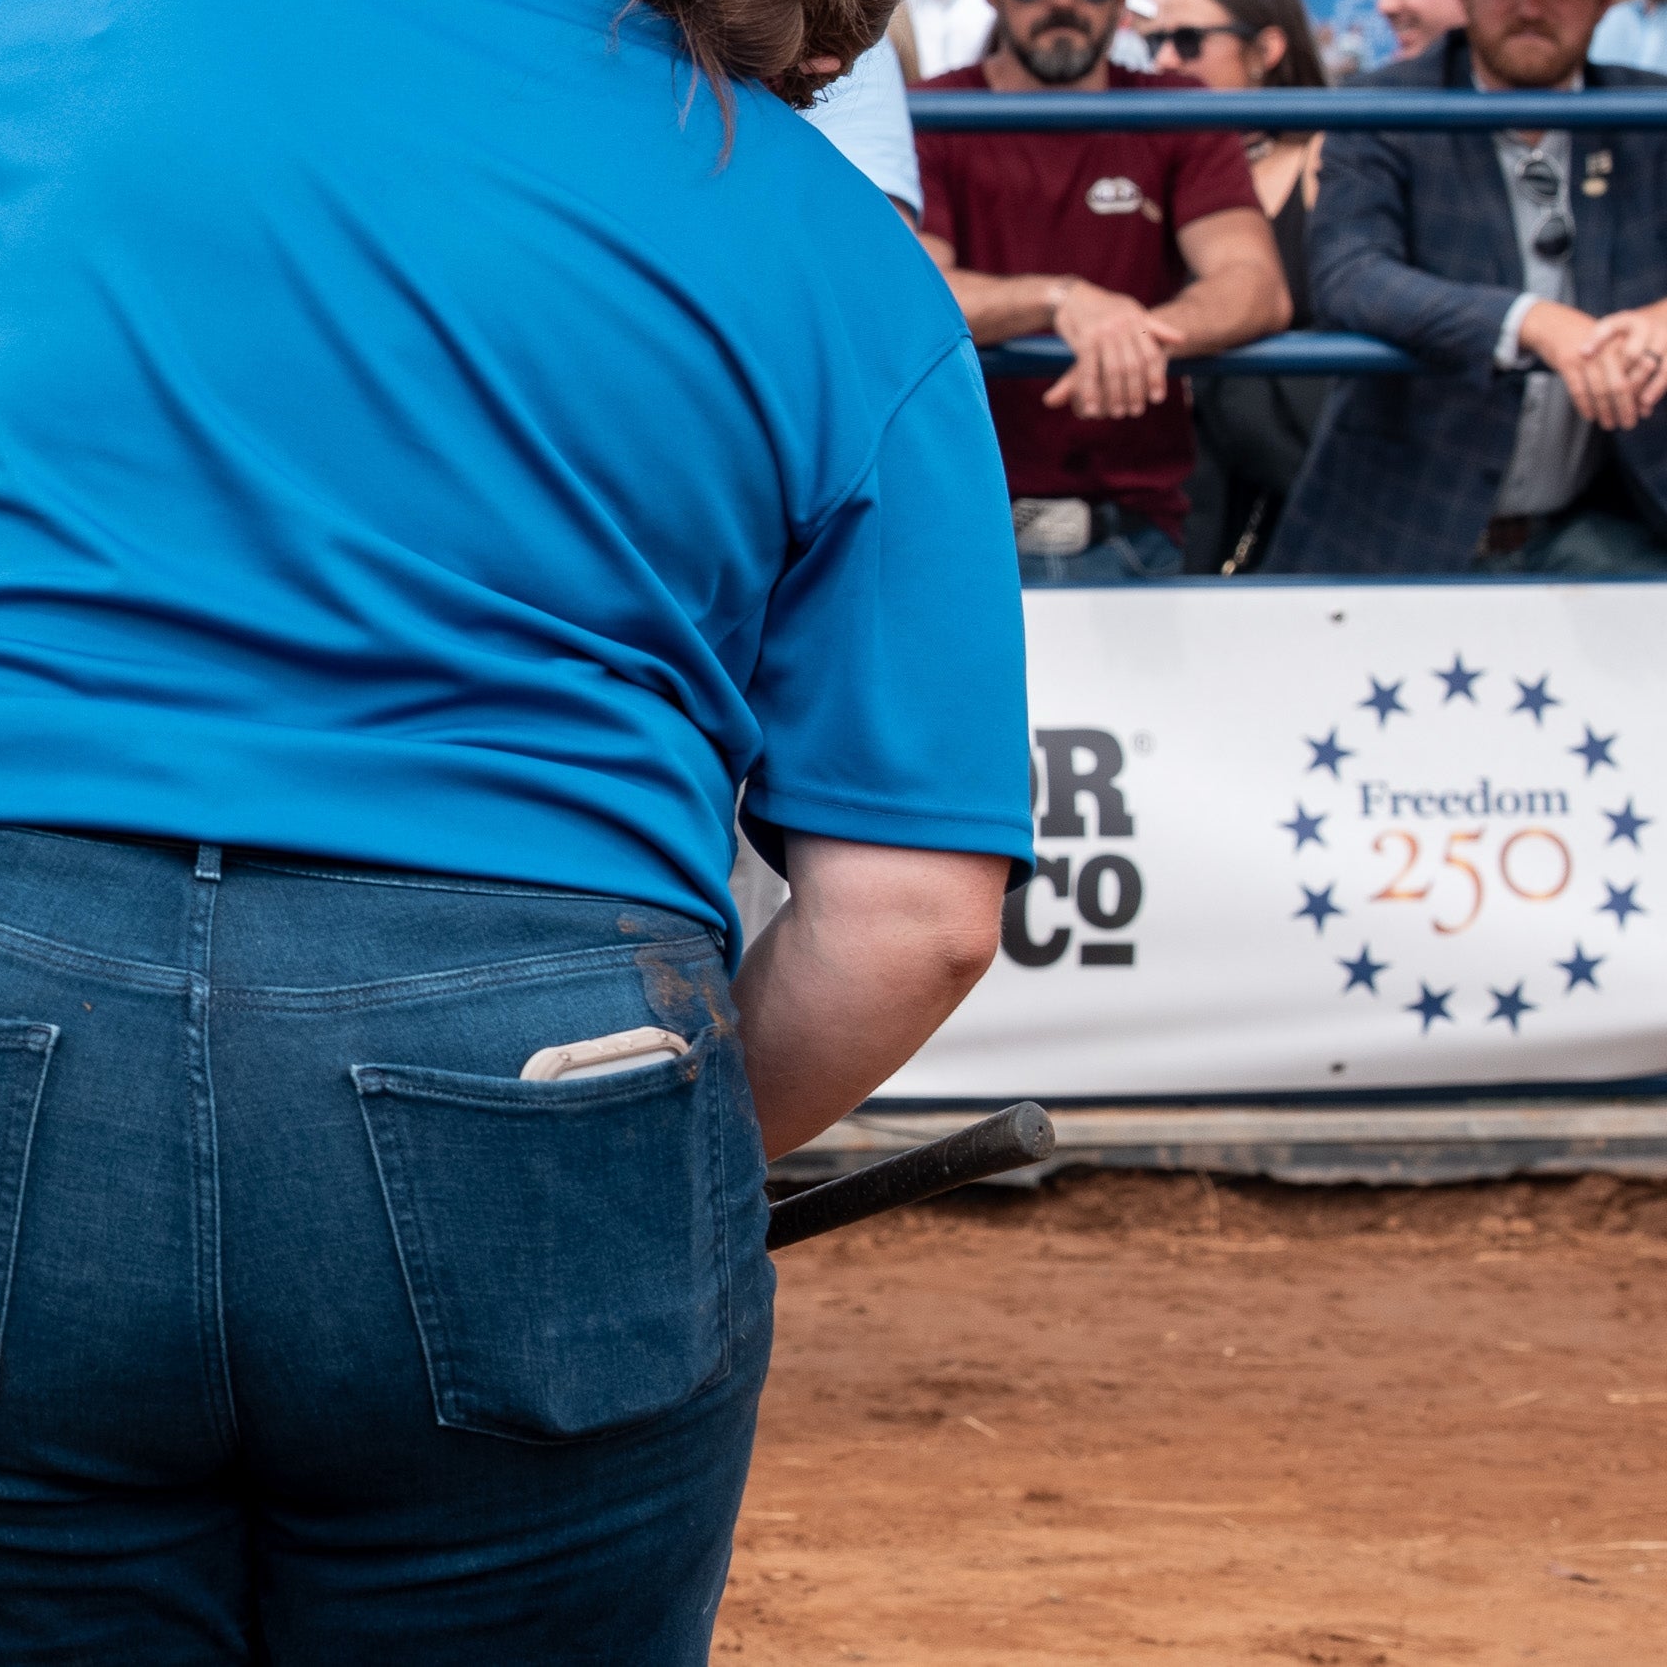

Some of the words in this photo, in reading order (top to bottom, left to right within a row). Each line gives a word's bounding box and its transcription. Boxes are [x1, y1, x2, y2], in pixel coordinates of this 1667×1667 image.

[1030, 729, 1135, 838] R
[1359, 777, 1571, 817] Freedom
[1368, 825, 1574, 936] 250
